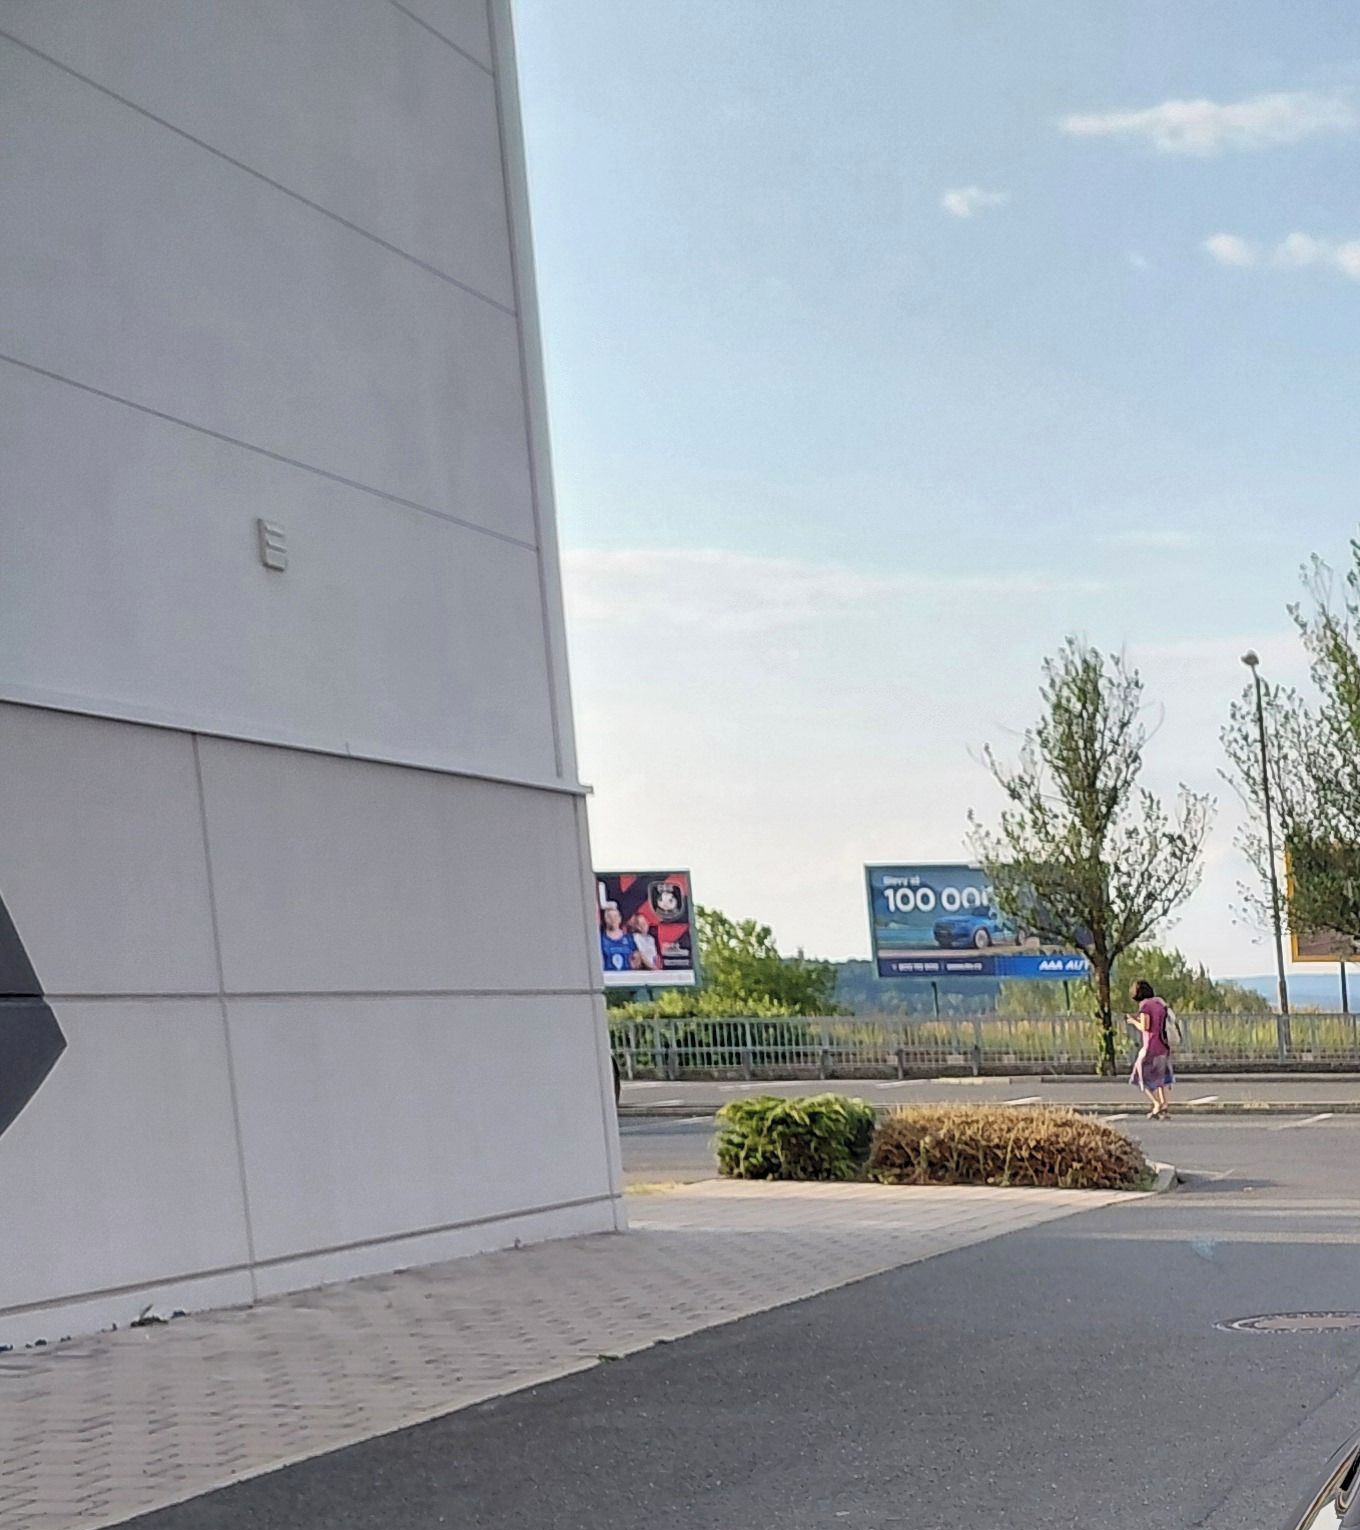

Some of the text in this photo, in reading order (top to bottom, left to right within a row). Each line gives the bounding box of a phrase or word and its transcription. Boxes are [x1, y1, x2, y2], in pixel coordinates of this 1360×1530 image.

[883, 887, 936, 913] 100
[1039, 960, 1089, 971] AAA AUT
